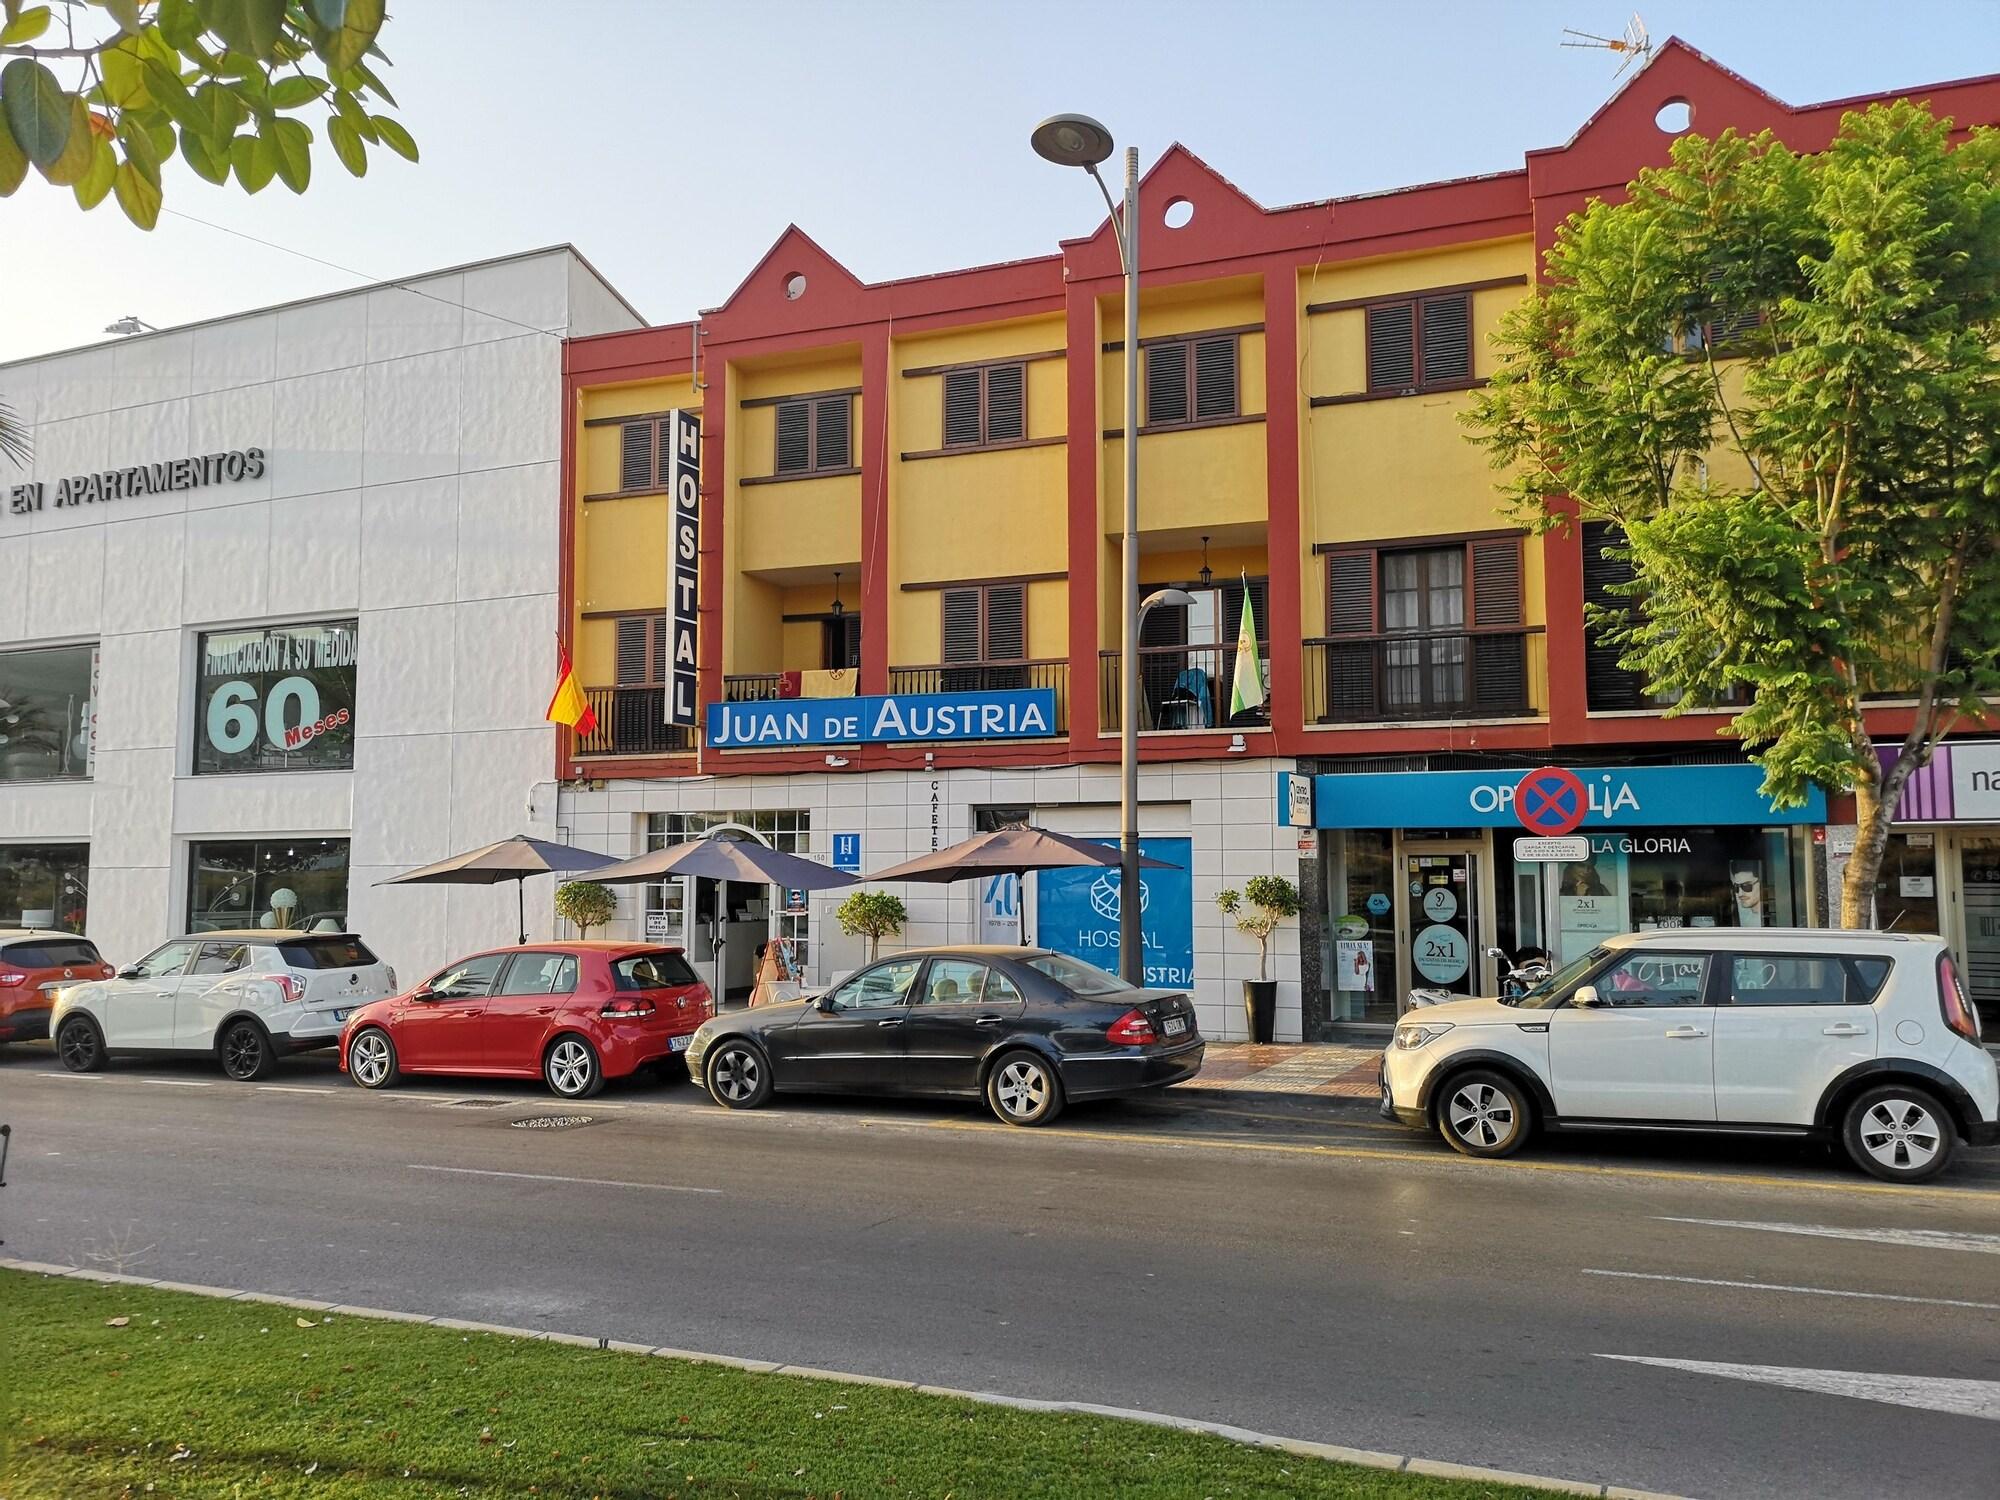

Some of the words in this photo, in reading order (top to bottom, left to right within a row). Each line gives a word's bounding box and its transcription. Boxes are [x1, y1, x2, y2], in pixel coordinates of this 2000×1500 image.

[9, 482, 42, 514] EN
[53, 447, 264, 508] APARTAMENTOS
[677, 419, 699, 717] HOSTAL
[282, 636, 291, 670] A
[295, 634, 311, 670] SU
[314, 630, 358, 669] MEDIDA
[206, 676, 320, 754] 60
[284, 707, 350, 748] Meses
[713, 706, 808, 743] JUAN
[824, 717, 859, 739] DE
[872, 698, 1047, 737] AUSTRIA
[1592, 838, 1614, 853] LA
[1619, 837, 1692, 854] GLORIA
[1577, 899, 1595, 909] 2x1
[1079, 930, 1164, 949] HOSAL
[1425, 940, 1456, 958] 2x1
